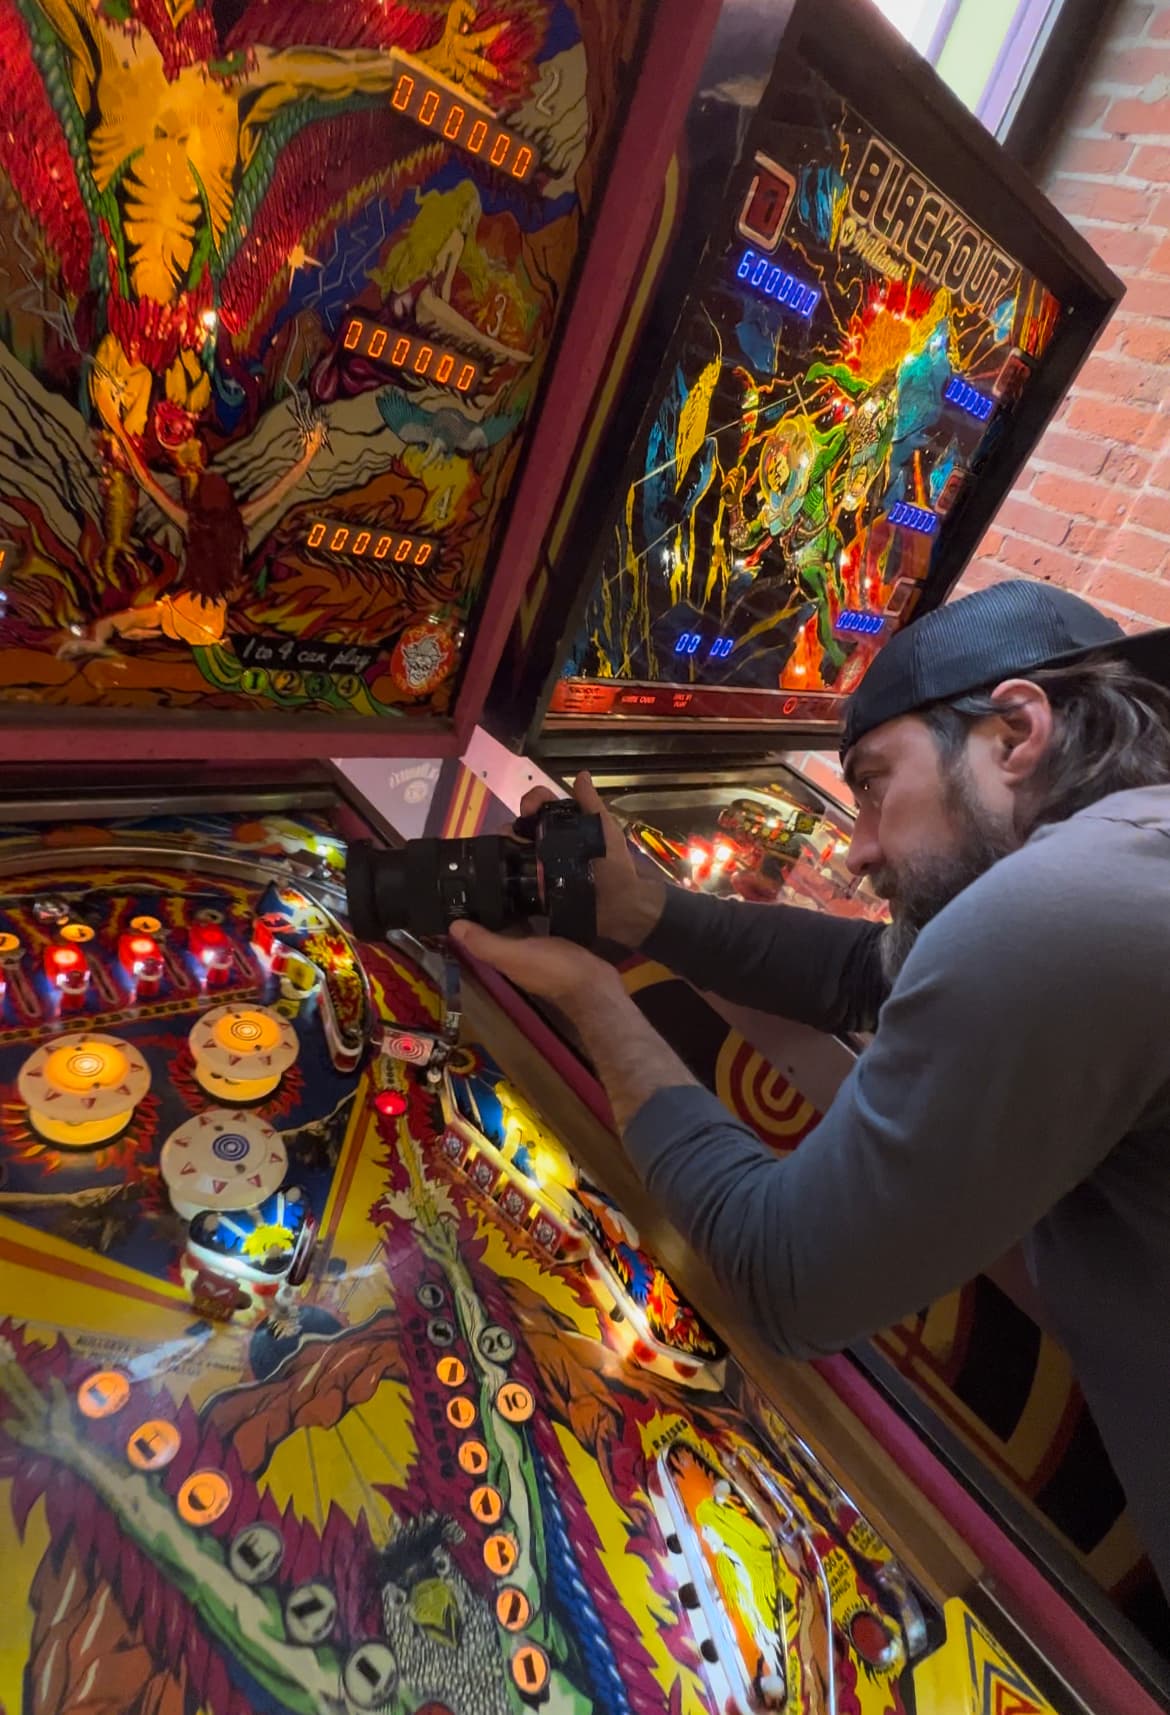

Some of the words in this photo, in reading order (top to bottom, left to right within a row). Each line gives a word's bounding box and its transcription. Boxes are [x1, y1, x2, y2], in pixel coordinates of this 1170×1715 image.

[538, 70, 560, 115] 2
[392, 74, 532, 178] 000000
[850, 137, 1022, 318] BLACKOUT
[854, 227, 908, 280] Williams
[737, 250, 821, 317] 600000
[343, 320, 475, 391] 000000
[308, 524, 432, 565] 000000
[255, 645, 272, 660] to
[279, 641, 294, 660] 4
[298, 651, 325, 663] can
[329, 648, 371, 673] play
[676, 633, 701, 653] 00
[710, 638, 734, 657] 00
[482, 1334, 512, 1354] 20
[504, 1392, 528, 1412] 10
